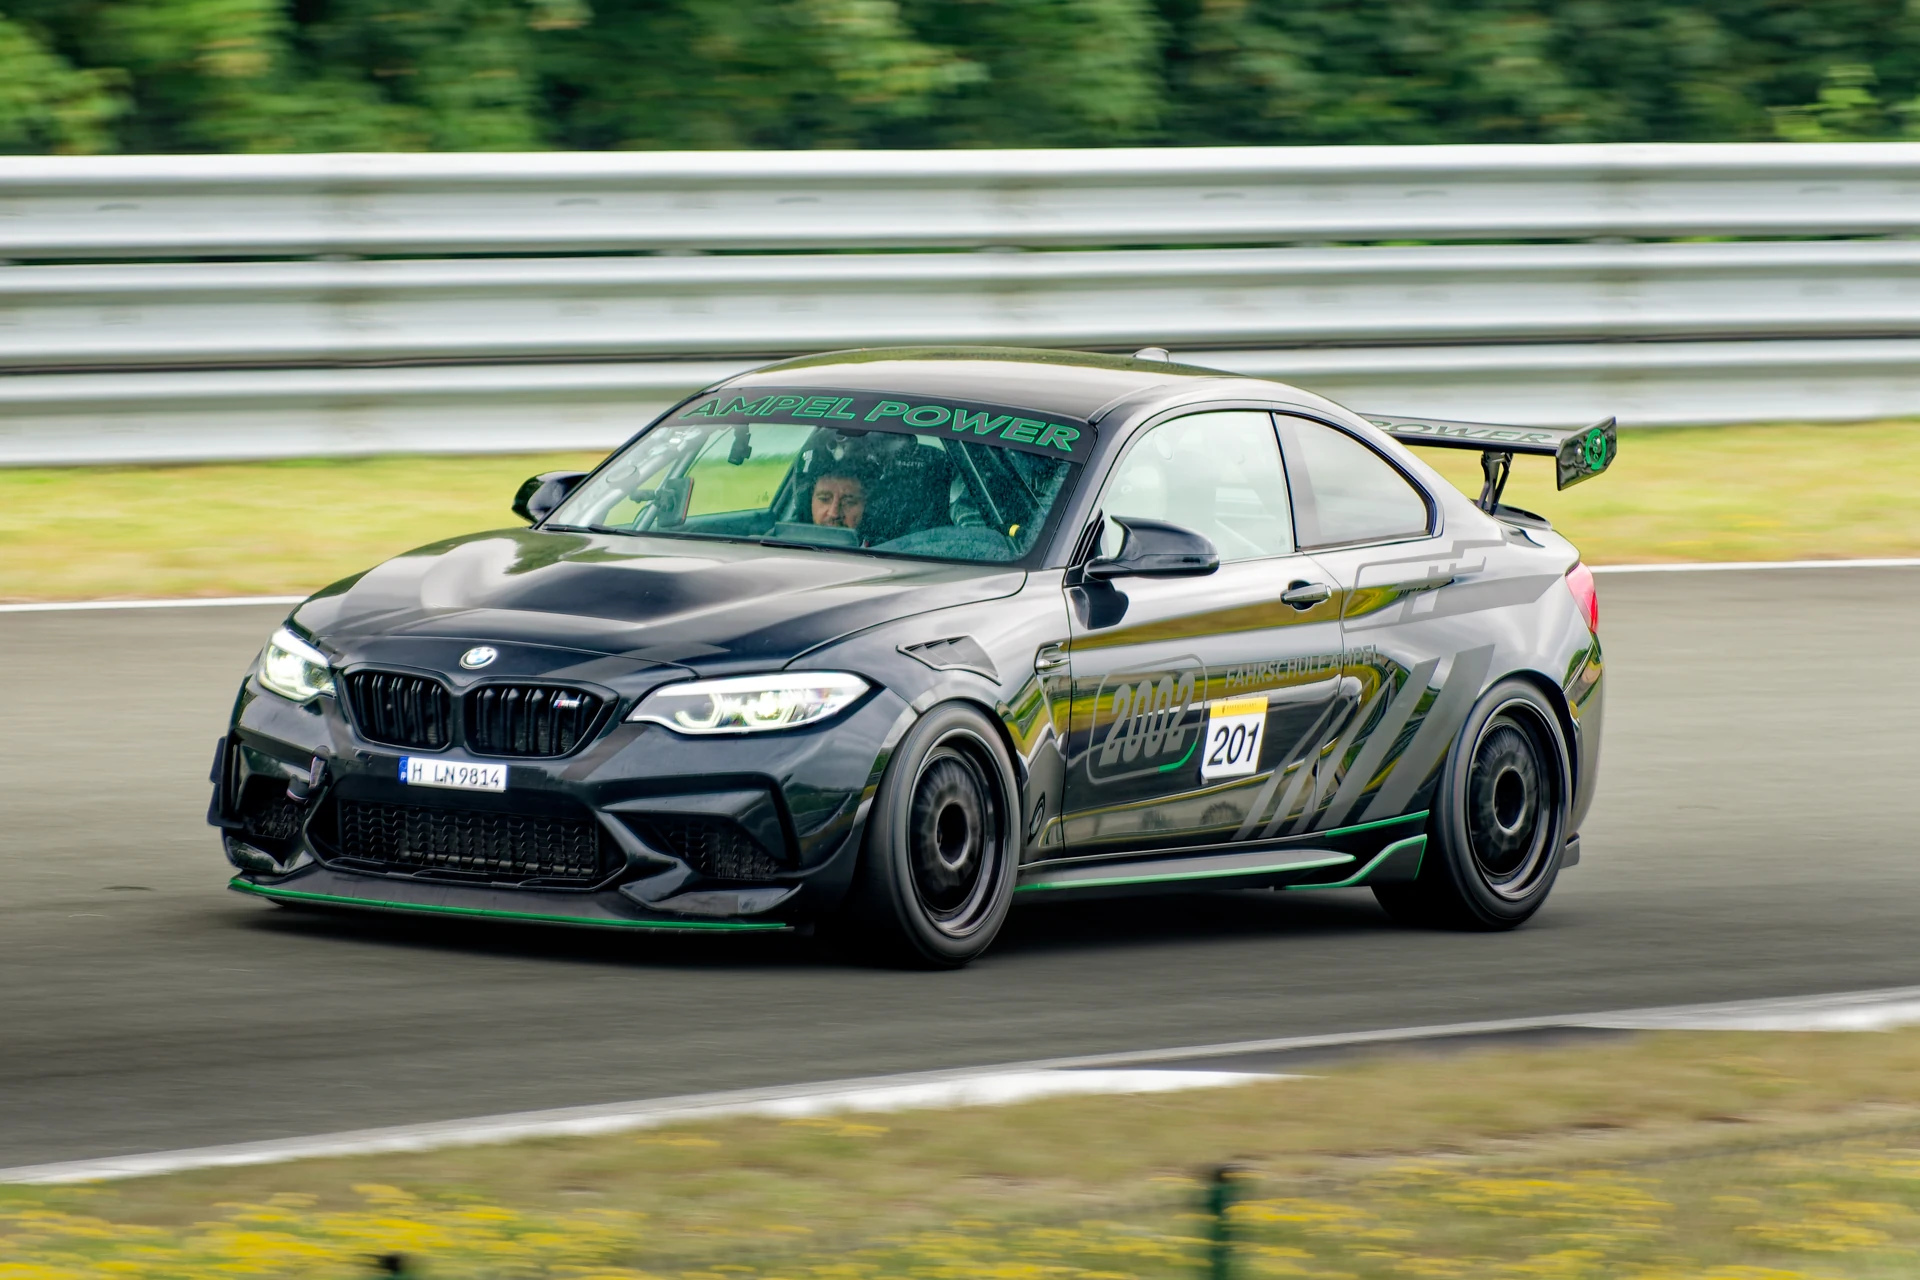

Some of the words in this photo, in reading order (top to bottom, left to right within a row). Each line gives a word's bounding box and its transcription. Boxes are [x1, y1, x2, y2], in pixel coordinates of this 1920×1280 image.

[678, 395, 857, 421] AMPEL
[863, 399, 1082, 453] POWER
[1098, 671, 1196, 767] 2002
[1206, 721, 1260, 767] 201
[412, 762, 423, 782] H
